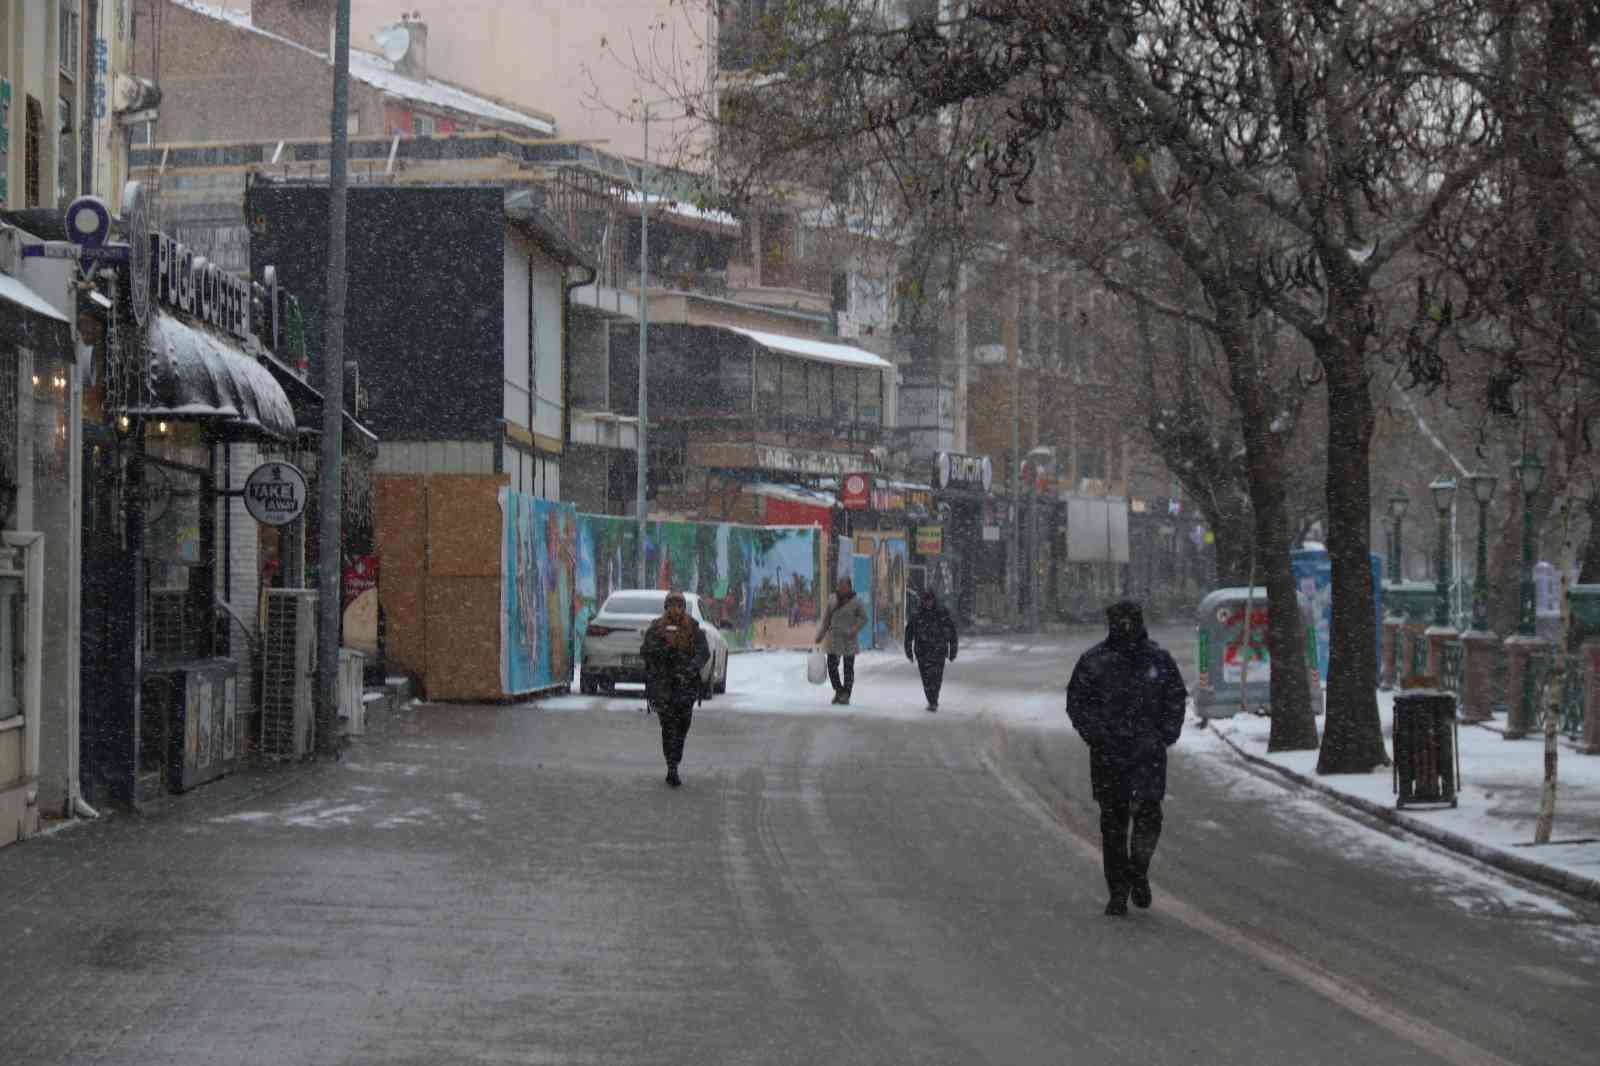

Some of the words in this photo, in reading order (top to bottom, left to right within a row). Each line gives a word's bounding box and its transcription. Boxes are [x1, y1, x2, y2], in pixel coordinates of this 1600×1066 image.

[200, 263, 250, 334] COFFEE
[249, 482, 294, 498] TAKE
[265, 498, 299, 512] AWAY
